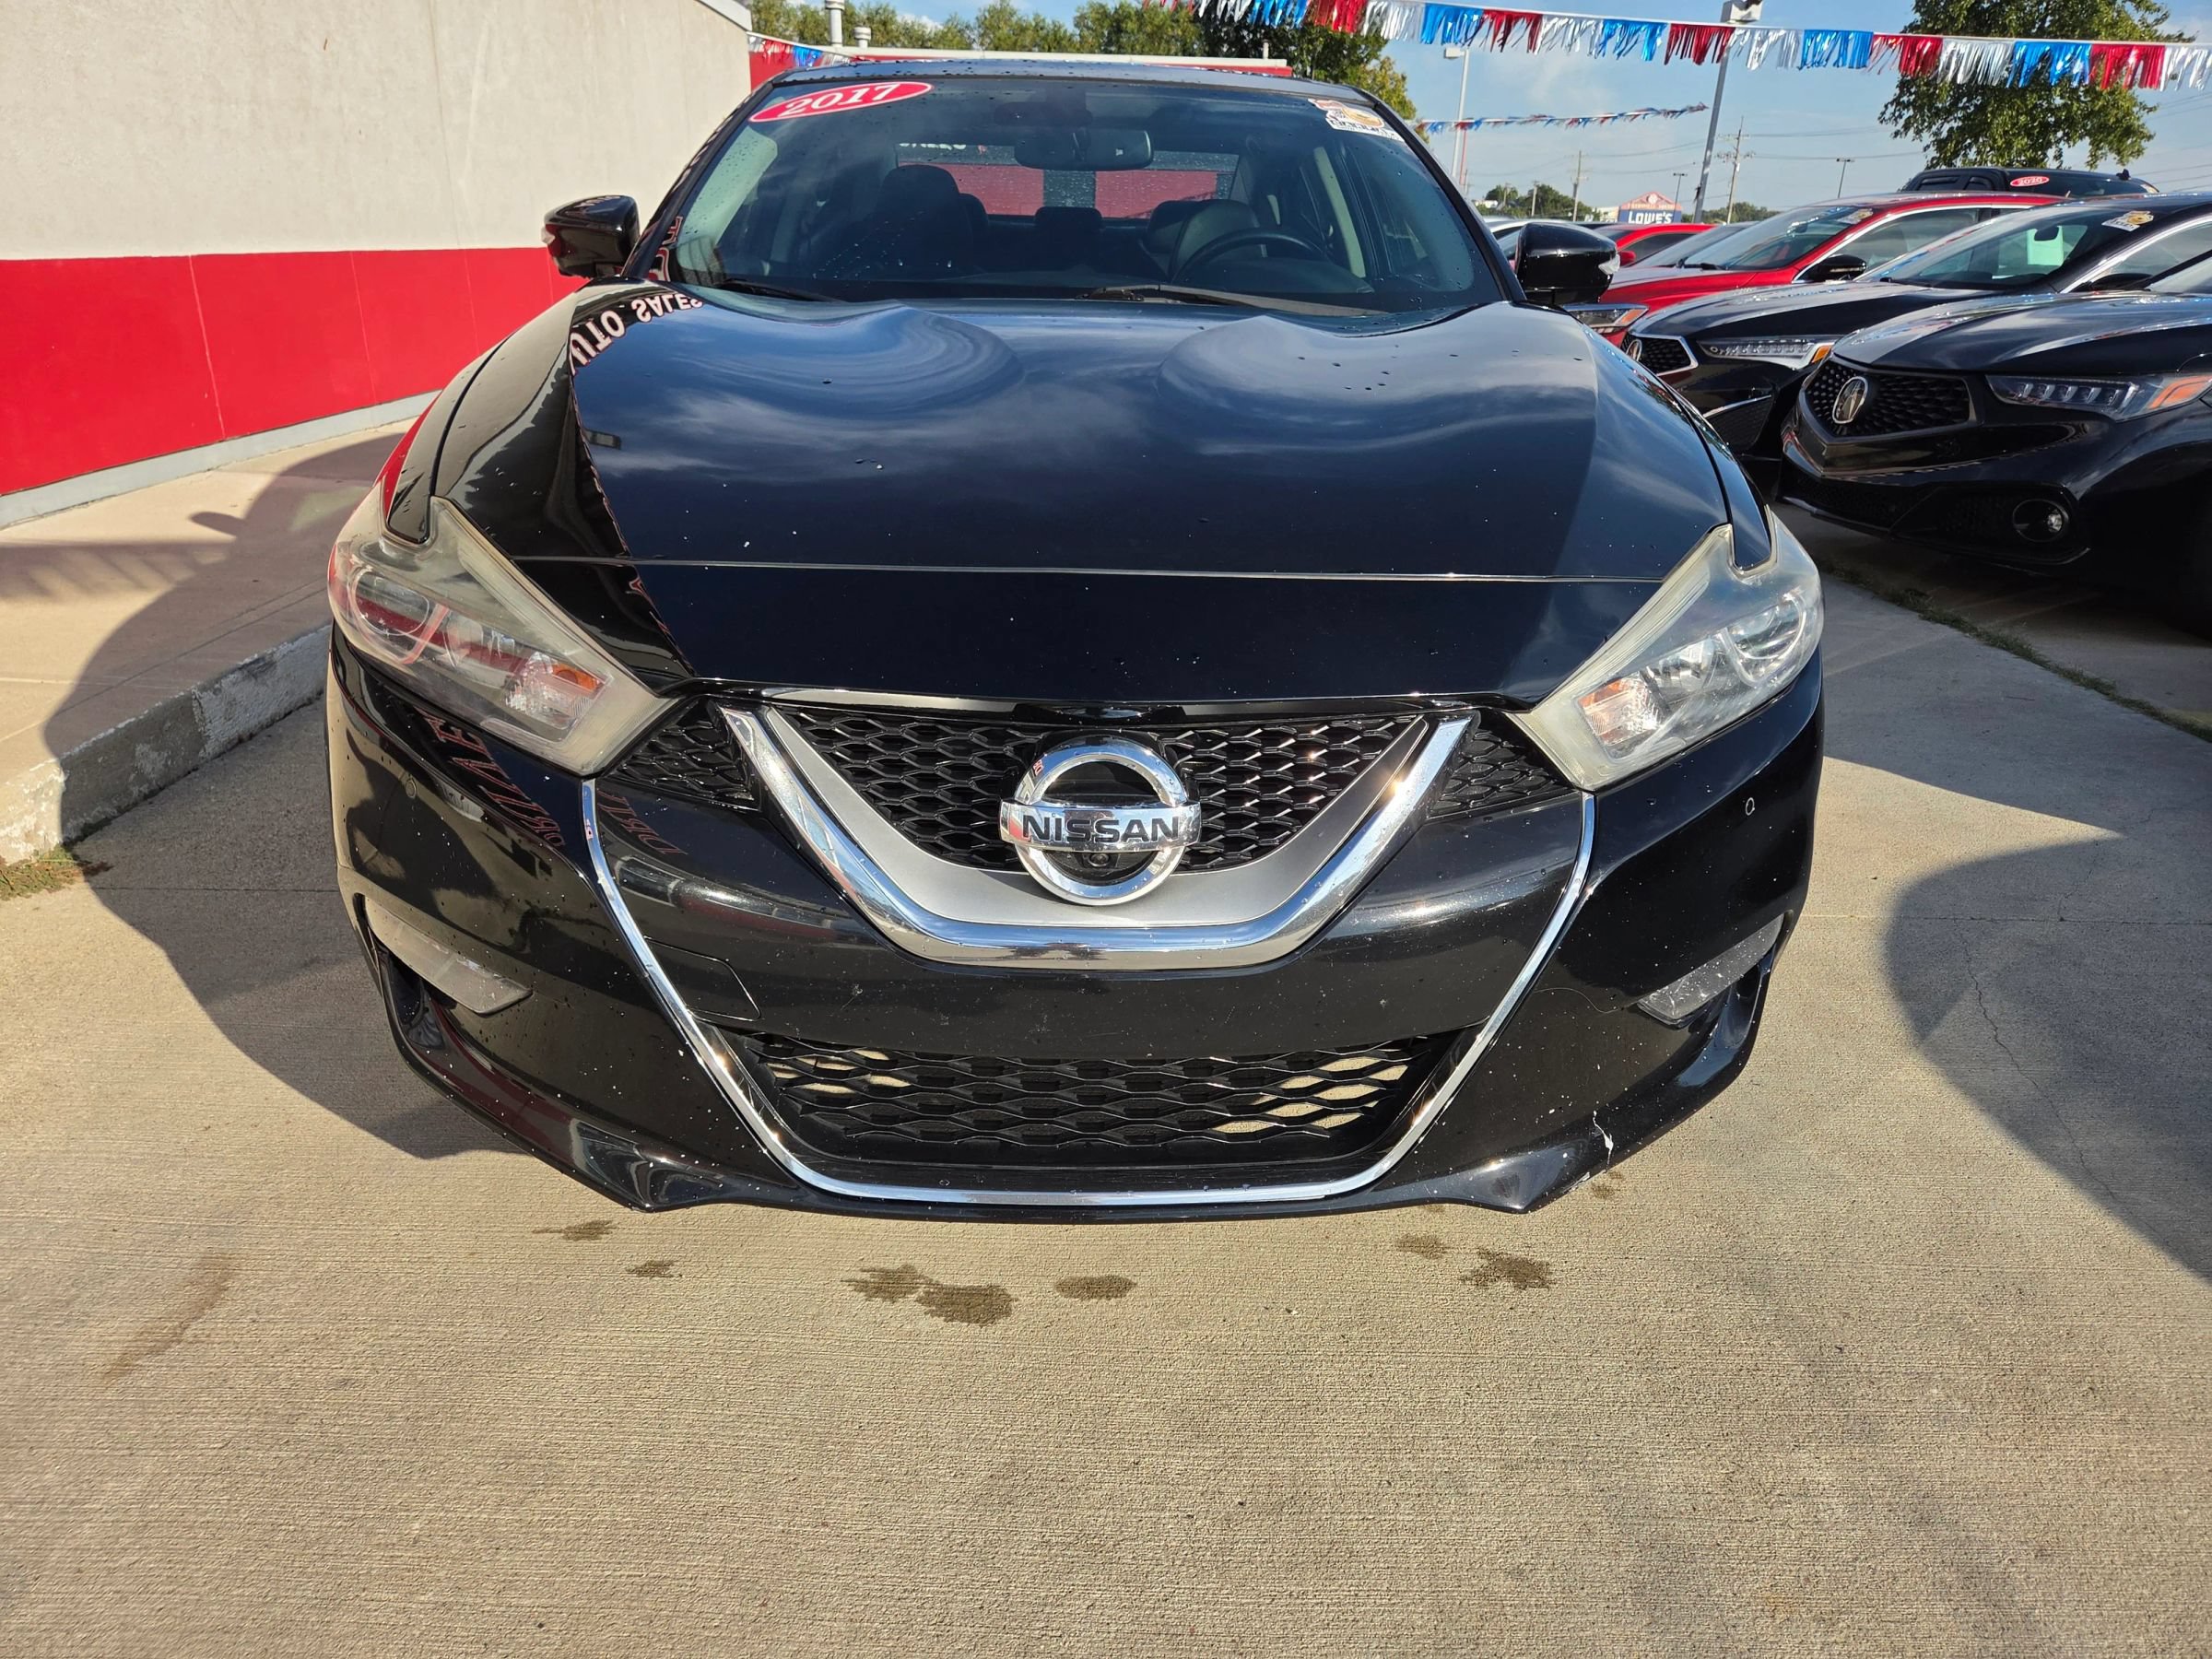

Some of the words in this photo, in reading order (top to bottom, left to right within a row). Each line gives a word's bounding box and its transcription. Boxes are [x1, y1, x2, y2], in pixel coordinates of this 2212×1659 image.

[777, 84, 900, 117] 2017
[1628, 211, 1673, 224] LOWE'S
[1023, 814, 1179, 842] NISSAN
